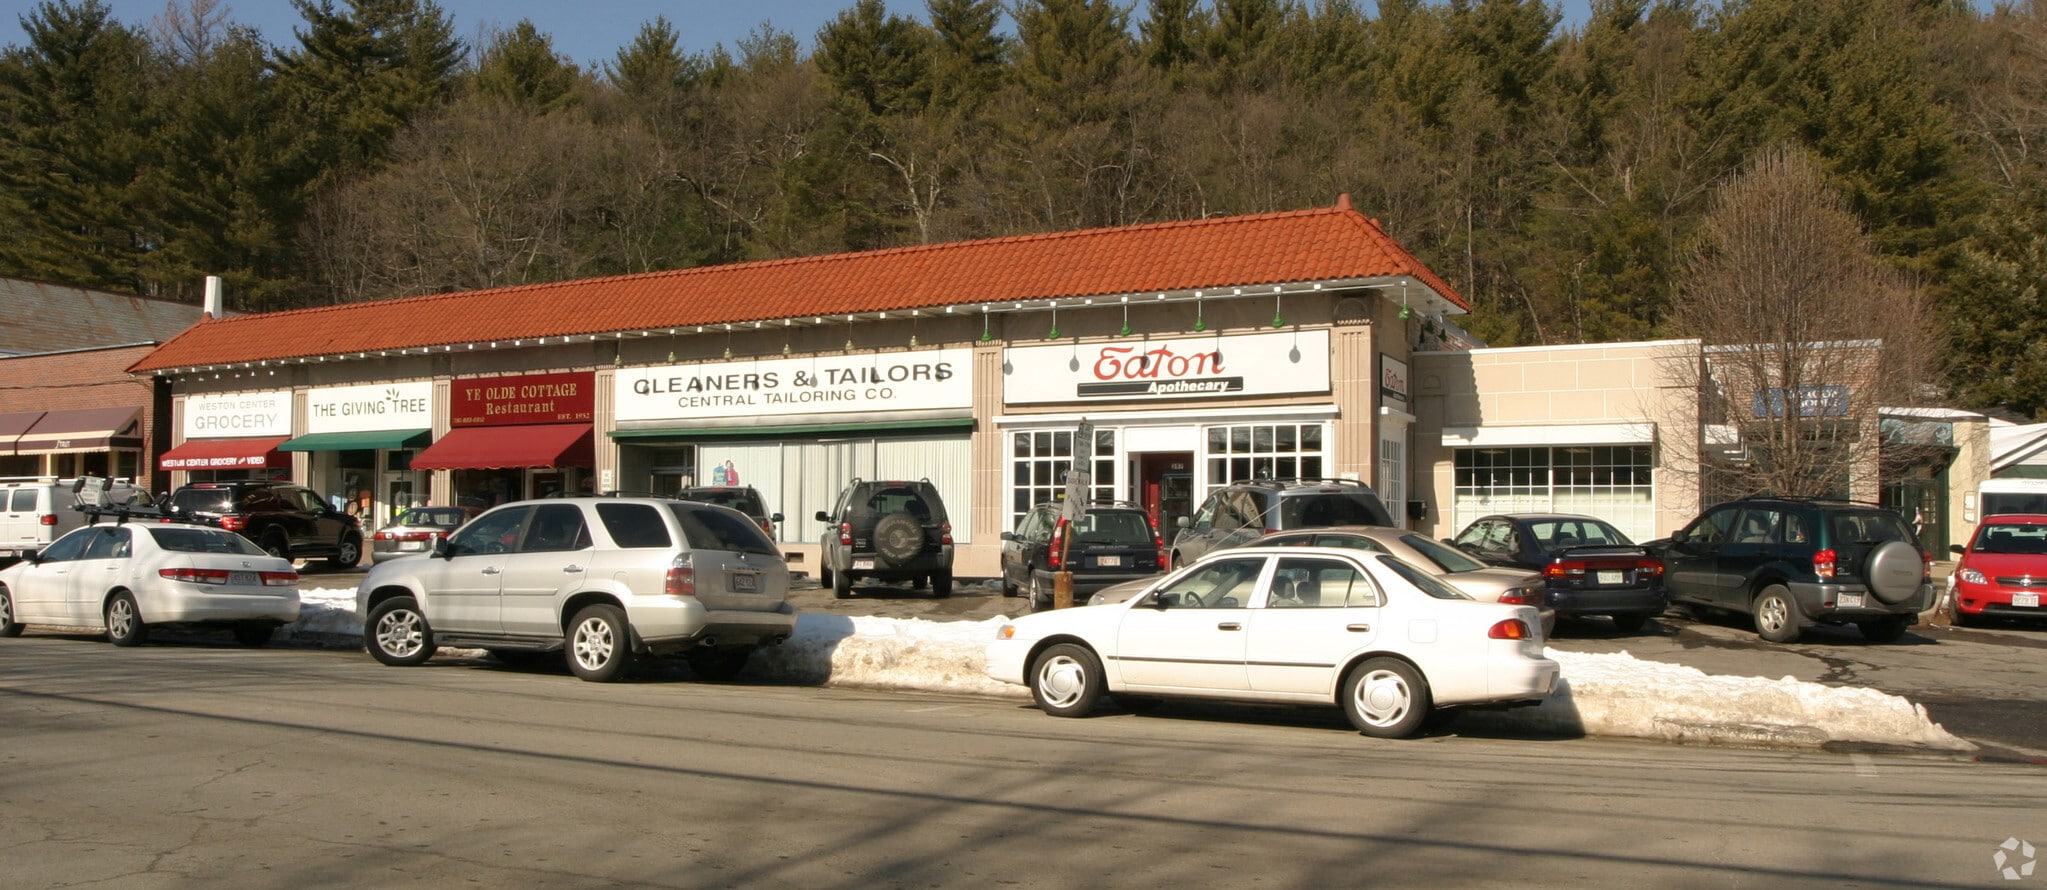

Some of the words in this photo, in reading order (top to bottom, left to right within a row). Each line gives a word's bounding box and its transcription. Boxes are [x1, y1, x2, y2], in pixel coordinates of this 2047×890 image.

[1093, 344, 1226, 380] Eaton
[633, 372, 779, 394] CLEANERS
[793, 370, 810, 387] &
[824, 362, 953, 385] TAILORS
[466, 388, 481, 401] YE
[486, 386, 516, 400] OLDE
[521, 383, 577, 399] COTTAGE
[1147, 380, 1229, 395] Apothecary
[199, 402, 235, 411] WESTON
[240, 400, 275, 409] CENTER
[678, 394, 757, 408] CENTRAL
[764, 388, 856, 404] TAILORING
[865, 387, 897, 400] CO.
[313, 403, 336, 417] THE
[342, 400, 385, 416] GIVING
[392, 398, 425, 413] TREE
[486, 400, 554, 415] Restaurant
[195, 413, 277, 429] GROCERY
[162, 459, 185, 467] WESTON
[186, 458, 208, 466] CENTER
[210, 457, 237, 465] GROCERY
[246, 456, 265, 465] VIDEO
